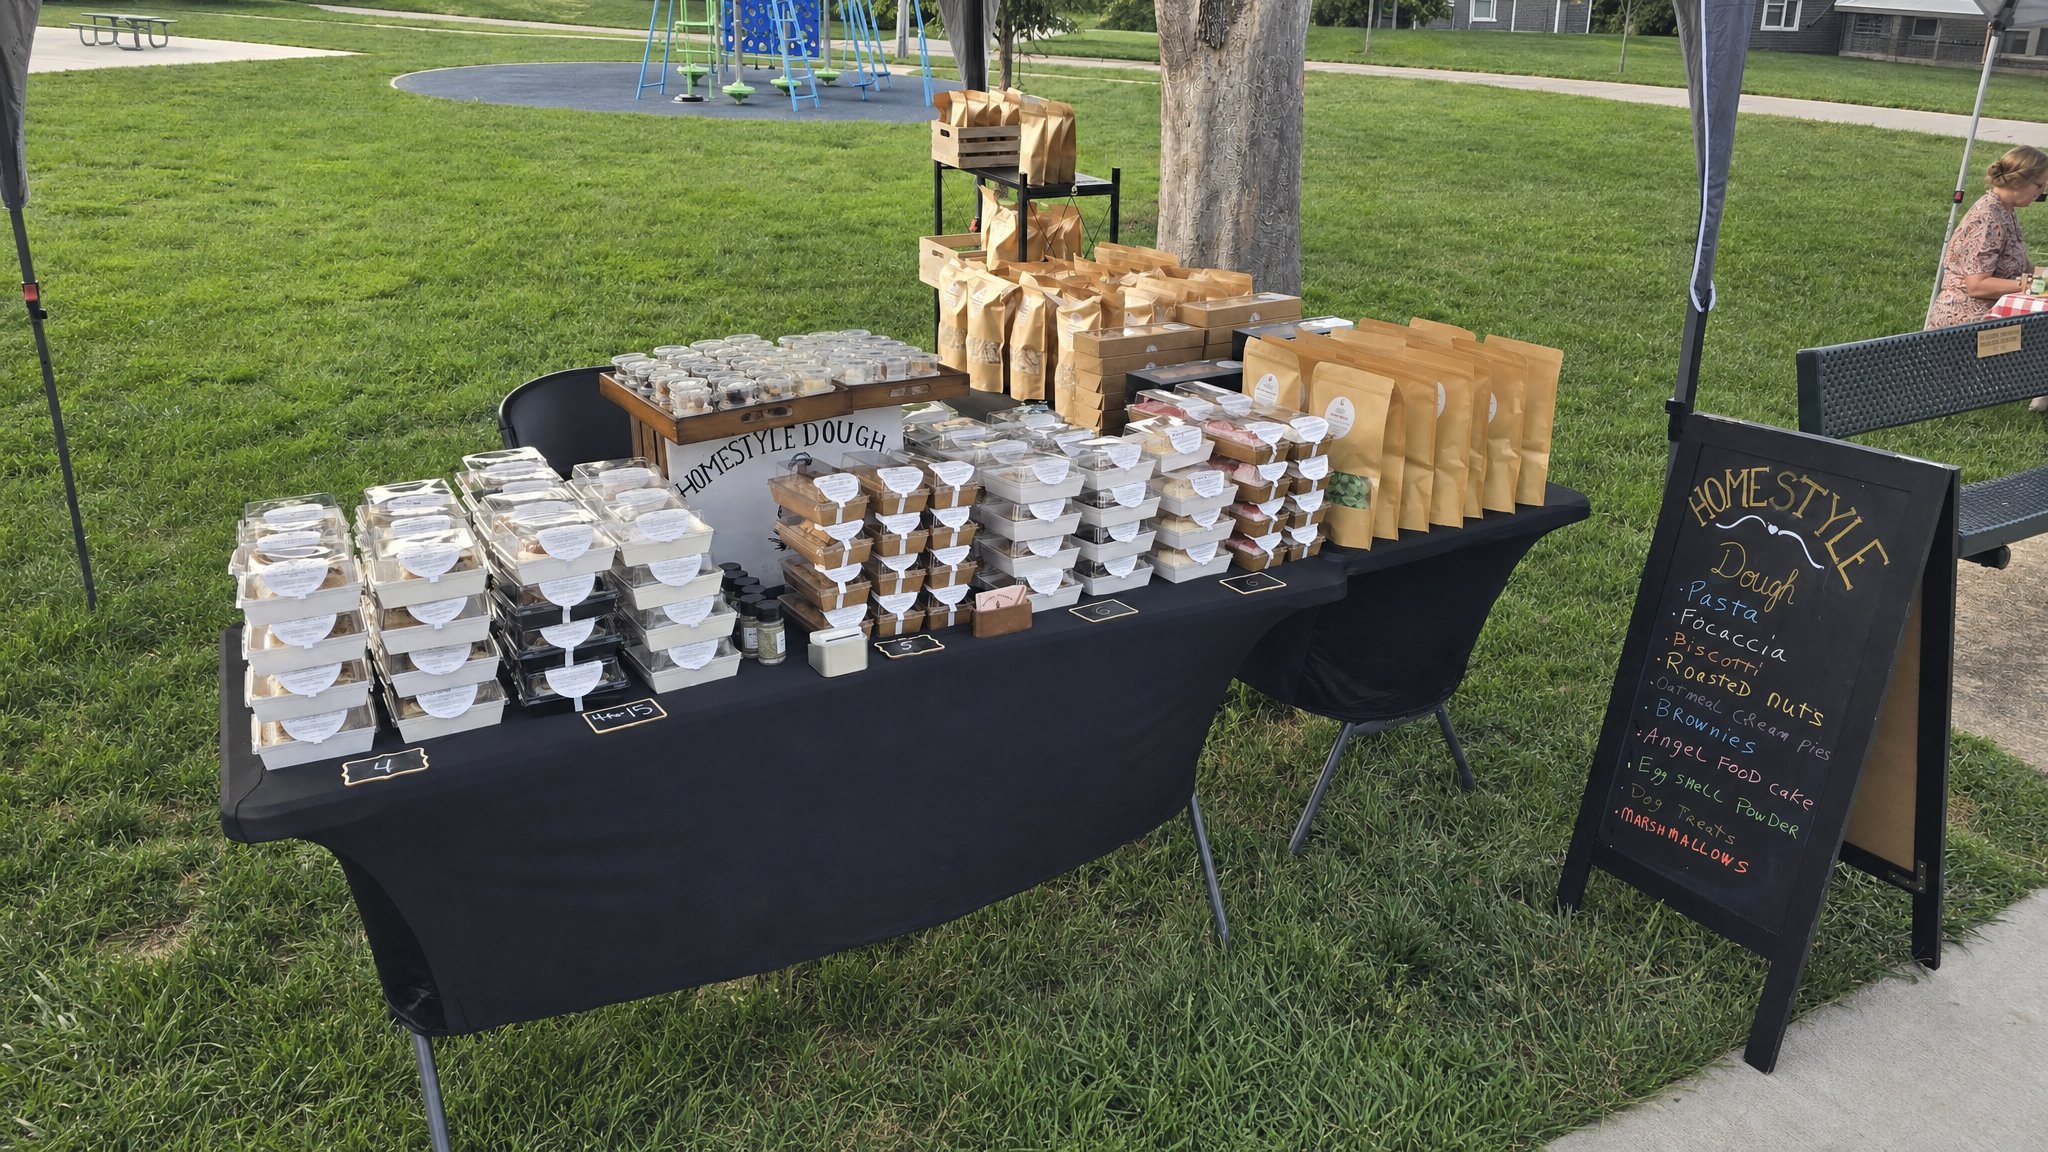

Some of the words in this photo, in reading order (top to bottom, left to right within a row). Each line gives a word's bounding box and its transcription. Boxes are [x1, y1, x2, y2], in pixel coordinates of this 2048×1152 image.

[675, 425, 796, 498] HOMESTYLE
[803, 420, 887, 452] DOUGH
[1688, 466, 1889, 590] HOMESTYLE
[1711, 541, 1799, 612] Dough
[1688, 580, 1758, 624] Pasta
[1674, 631, 1763, 676] Biscotti
[1680, 608, 1787, 662] Focaccia
[592, 713, 605, 721] 4
[626, 704, 653, 717] 15
[374, 759, 393, 773] 4
[1638, 756, 1667, 785] Egg
[1631, 783, 1662, 811] Dog
